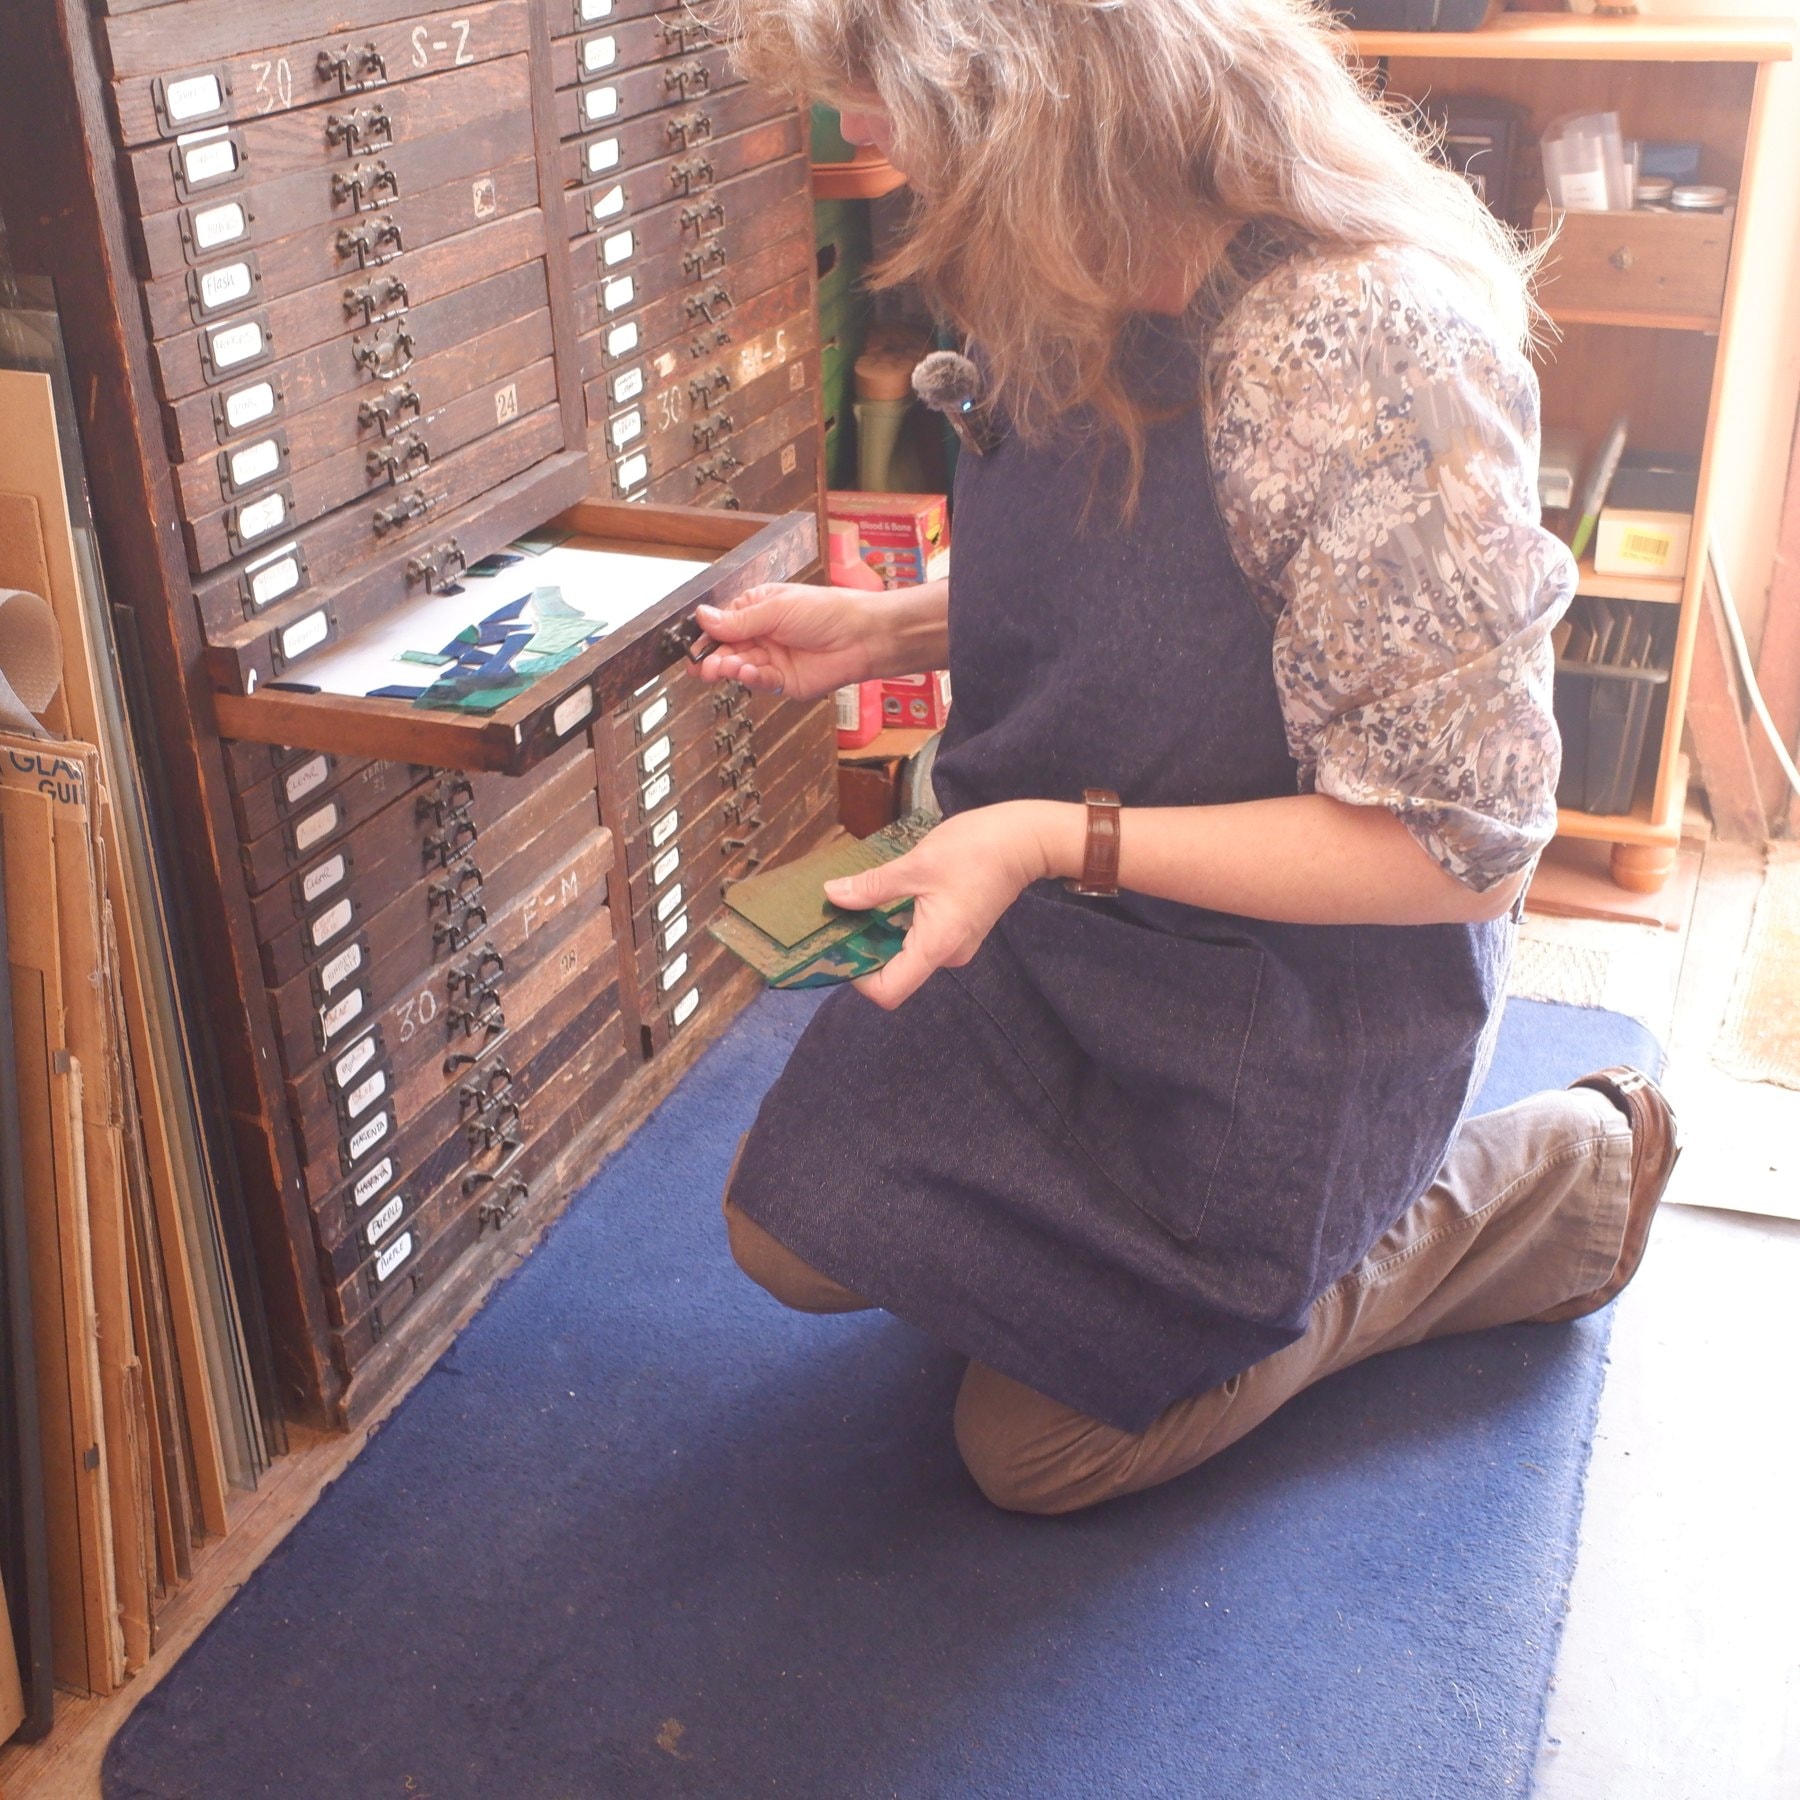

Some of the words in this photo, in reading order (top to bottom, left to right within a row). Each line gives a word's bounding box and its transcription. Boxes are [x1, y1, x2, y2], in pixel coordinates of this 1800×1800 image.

[410, 18, 474, 69] S-Z
[250, 57, 292, 114] 30
[206, 271, 235, 297] Flash
[497, 389, 516, 418] 24
[656, 385, 682, 430] 30
[395, 989, 437, 1043] 30
[352, 1119, 386, 1148] MAGENTA
